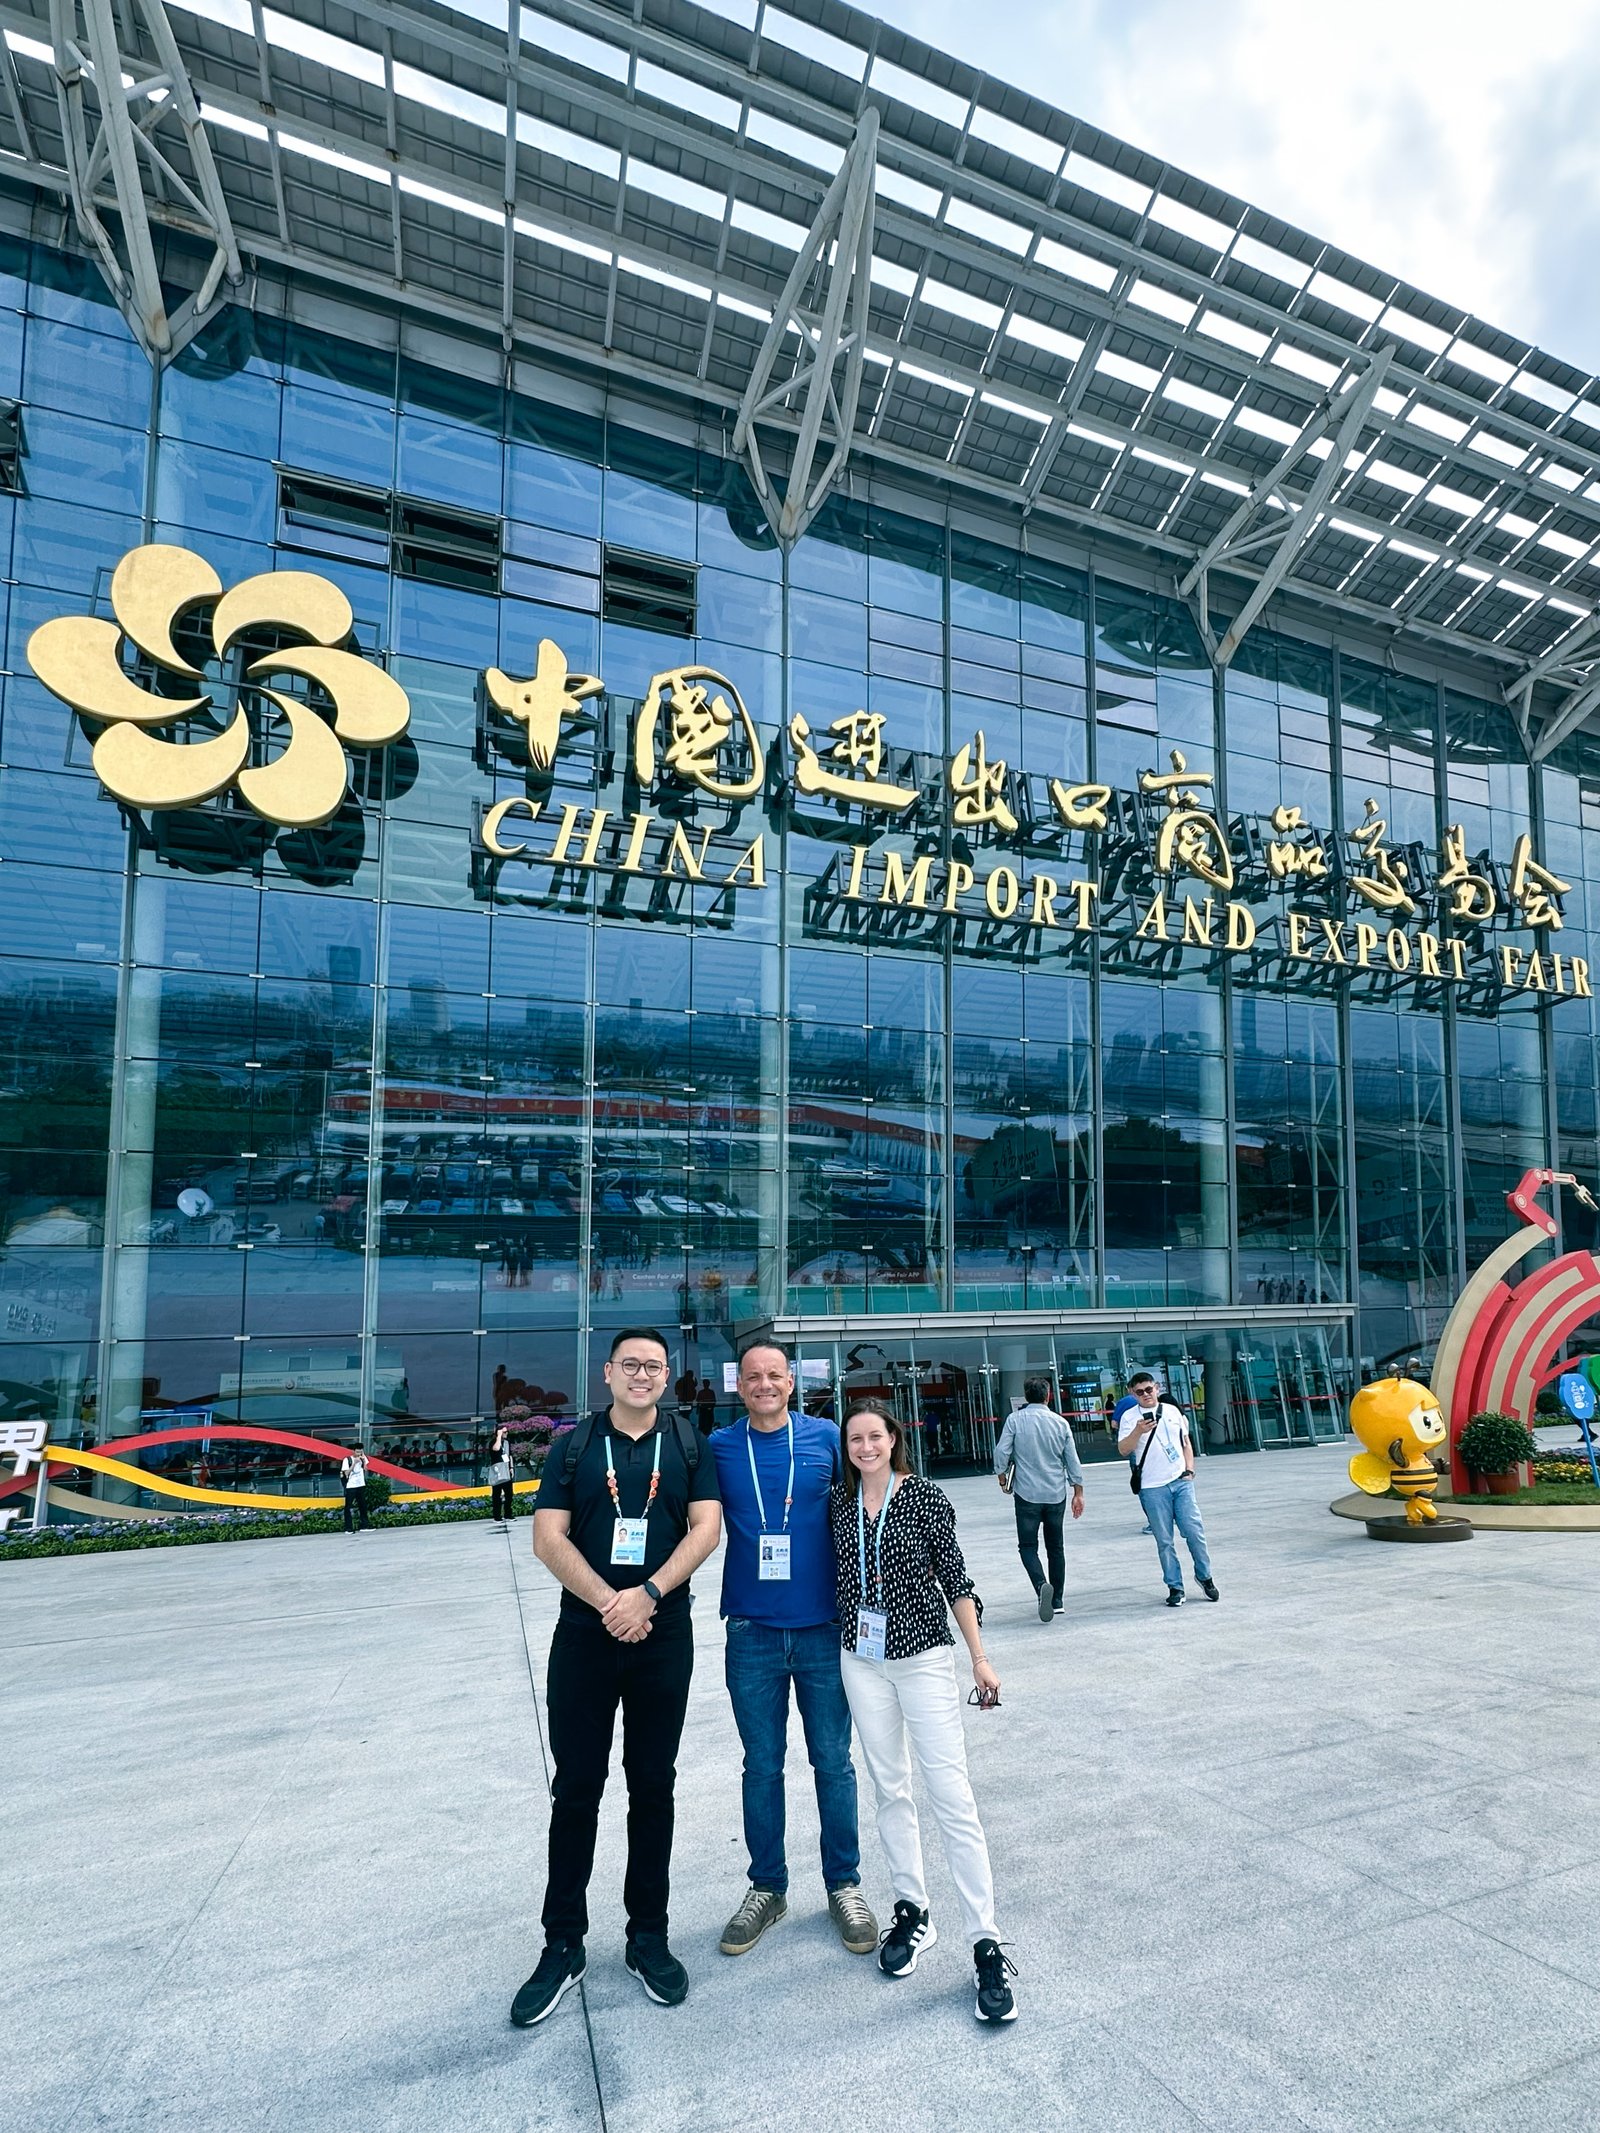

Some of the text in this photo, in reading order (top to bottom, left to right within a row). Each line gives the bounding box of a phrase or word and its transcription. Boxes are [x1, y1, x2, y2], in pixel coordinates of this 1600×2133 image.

[481, 796, 1594, 998] CHINA IMPORT AND EXPORT FAIR
